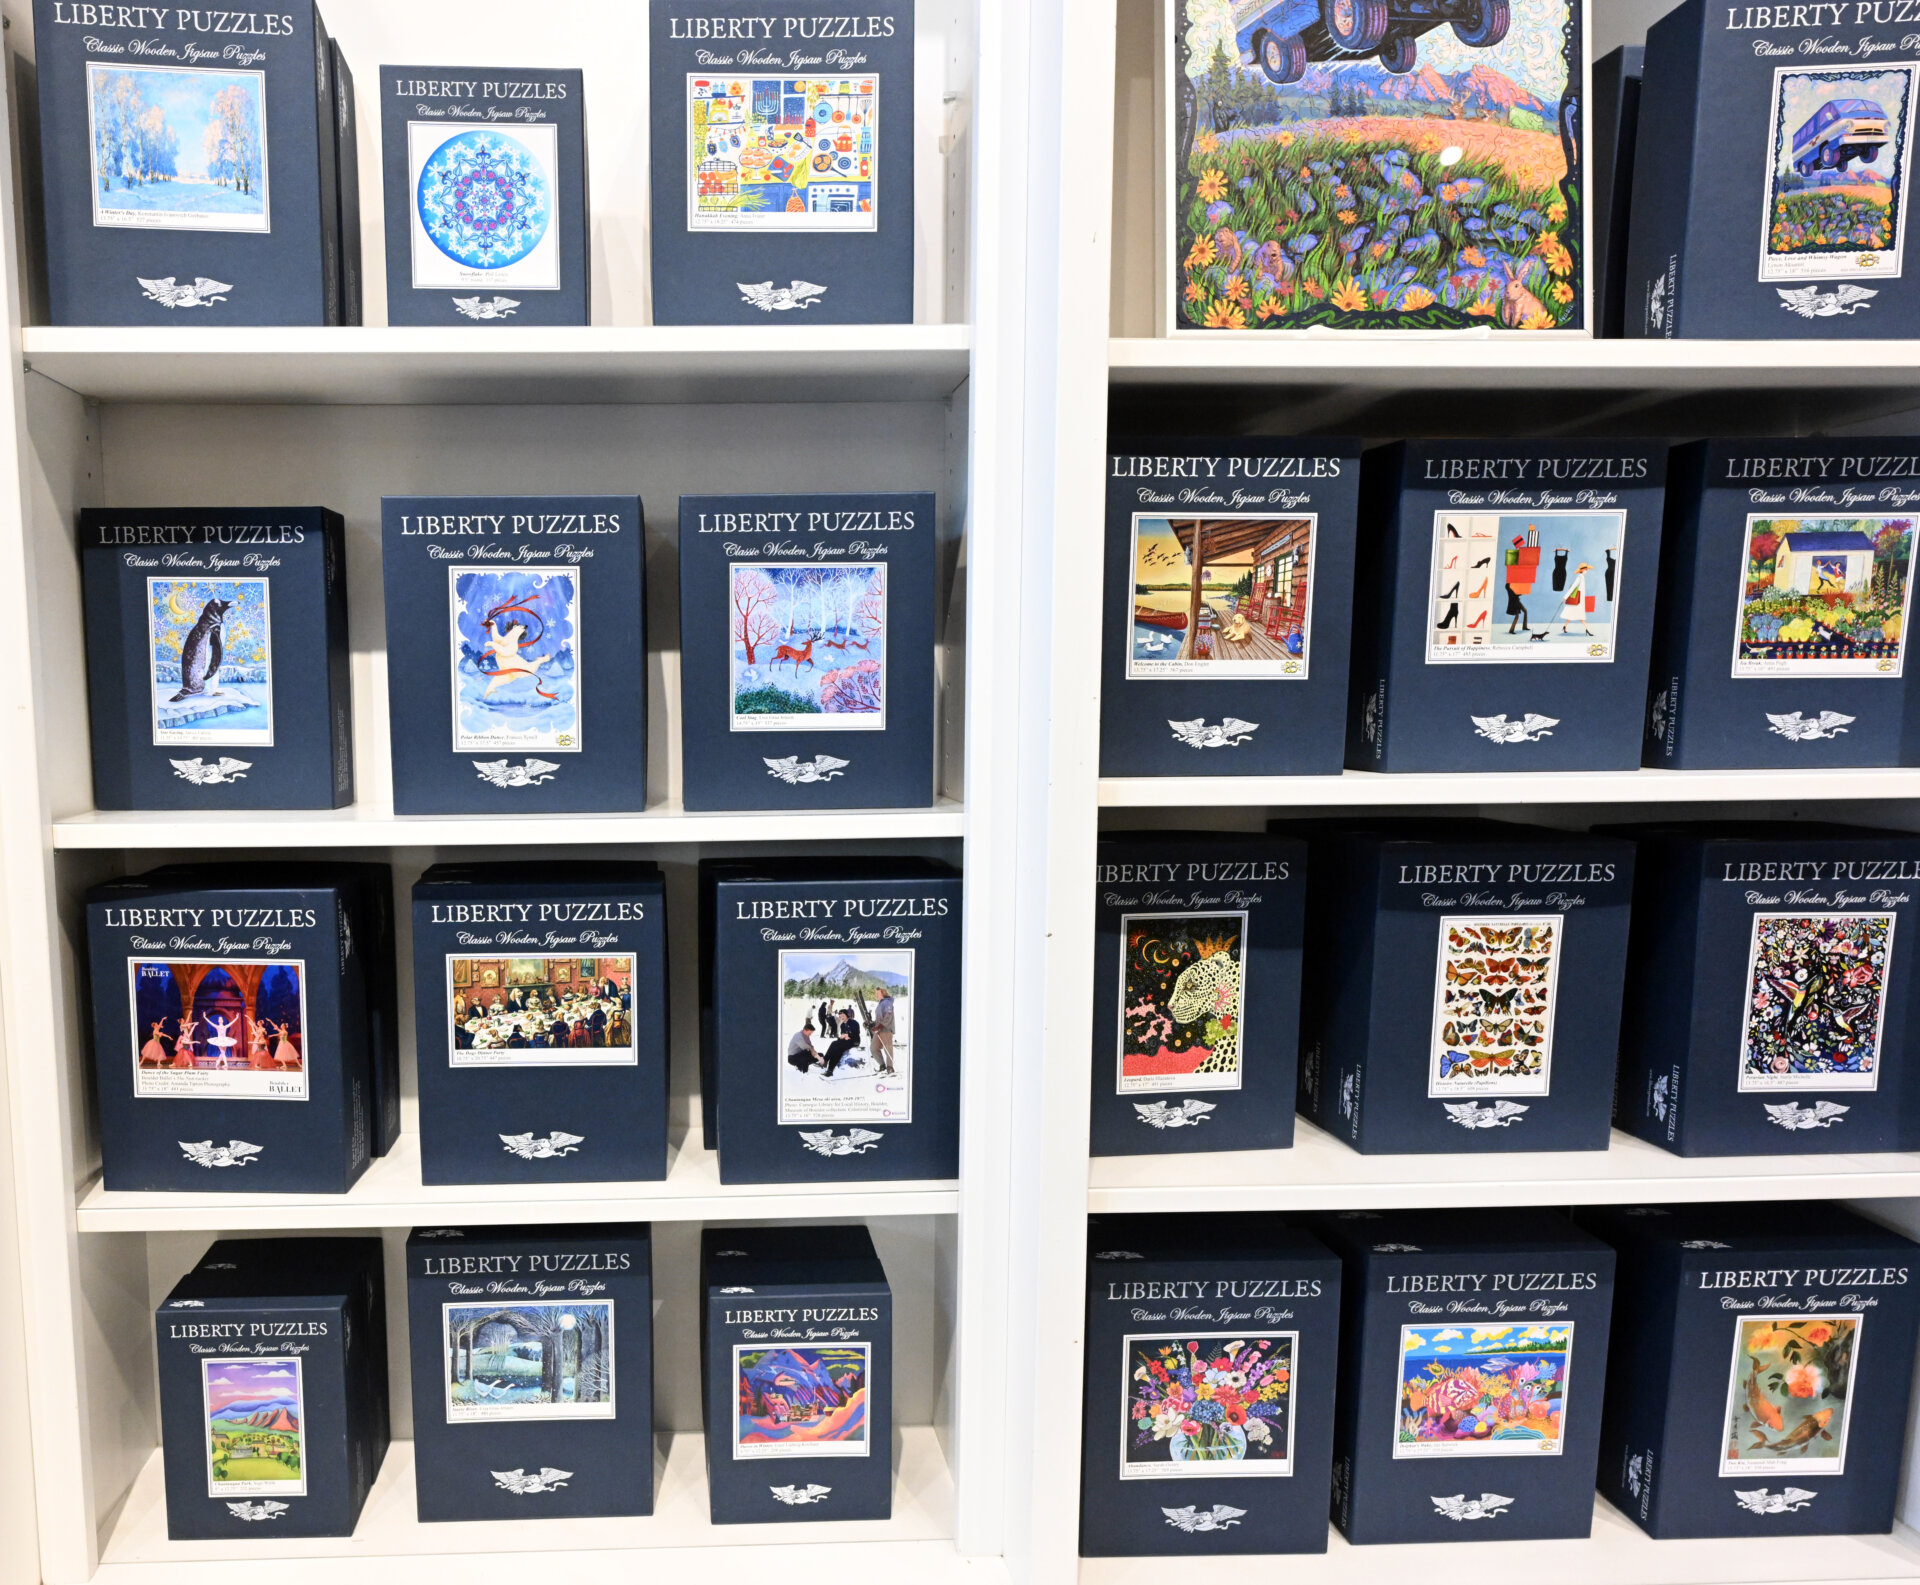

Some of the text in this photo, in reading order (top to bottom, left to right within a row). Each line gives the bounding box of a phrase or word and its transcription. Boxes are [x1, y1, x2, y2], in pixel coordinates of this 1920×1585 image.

[54, 2, 293, 35] LIBERTY PUZZLES
[1726, 3, 1849, 29] LIBERTY
[670, 17, 894, 38] LIBERTY PUZZLES
[83, 36, 265, 66] Classic Wooden Jigsaw Puzzles
[1752, 40, 1794, 56] Classic
[1799, 36, 1850, 54] Wooden
[1849, 36, 1896, 58] Jigsaw
[695, 48, 867, 70] Classic Wooden Jigsaw Puzzles
[396, 80, 566, 99] LIBERTY PUZZLES
[416, 104, 546, 122] Classic Wooden Jigsaw Puzzles
[1665, 254, 1677, 339] LIBERTY PUZZLE
[1112, 457, 1340, 477] LIBERTY PUZZLES
[1424, 458, 1647, 478] LIBERTY PUZZLES
[1726, 457, 1834, 477] LIBERTY
[1137, 487, 1310, 508] Classic Wooden Jigsaw Puzzles
[1448, 491, 1617, 508] Classic Wooden Jigsaw Puzzles
[1749, 486, 1920, 507] Classic Wooden Jigsaw Puzzles
[401, 515, 619, 535] LIBERTY PUZZLES
[699, 512, 914, 532] LIBERTY PUZZLES
[100, 526, 304, 544] LIBERTY PUZZLES
[427, 543, 594, 563] Classic Wooden Jigsaw Puzzles
[723, 540, 888, 560] Classic Wooden Jigsaw Puzzles
[124, 552, 280, 571] Classic Wooden Jigsaw Puzzles
[1669, 676, 1678, 715] LIBERTY
[1097, 862, 1288, 882] IBERTY PUZZLES
[1399, 864, 1615, 883] LIBERTY PUZZLES
[1722, 862, 1827, 881] LIBERTY
[1104, 890, 1262, 909] Classic Wooden Jigsaw Puzzles
[1422, 891, 1585, 910] Classic Wooden Jigsaw Puzzles
[1745, 889, 1910, 908] Classic Wooden Jigsaw Puzzles
[105, 909, 315, 927] LIBERTY PUZZLES
[432, 903, 643, 922] LIBERTY PUZZLES
[737, 898, 948, 919] LIBERTY PUZZLES
[130, 935, 291, 954] Classic Wooden Jigsaw Puzzles
[456, 930, 618, 948] Classic Wooden Jigsaw Puzzles
[761, 926, 922, 944] Classic Wooden Jigsaw Puzzles
[141, 970, 170, 978] BALLET
[269, 1085, 302, 1094] BALLET
[1670, 1064, 1679, 1102] LIBERTY
[425, 1254, 630, 1274] LIBERTY PUZZLES
[1386, 1273, 1596, 1293] LIBERTY PUZZLES
[1699, 1268, 1908, 1288] LIBERTY PUZZLES
[449, 1279, 605, 1297] Classic Wooden Jigsaw Puzzles
[1108, 1280, 1321, 1300] LIBERTY PUZZLES
[1408, 1299, 1568, 1317] Classic Wooden Jigsaw Puzzles
[1721, 1294, 1878, 1312] Classic Wooden Jigsaw Puzzles
[725, 1308, 878, 1323] LIBERTY PUZZLES
[1131, 1306, 1293, 1324] Classic Wooden Jigsaw Puzzles
[171, 1323, 327, 1338] LIBERTY PUZZLES
[743, 1327, 859, 1340] Classic Wooden Jigsaw Puzzles
[189, 1342, 309, 1357] Classic Wooden Jigsaw Puzzles
[1644, 1449, 1653, 1484] LIBERTY
